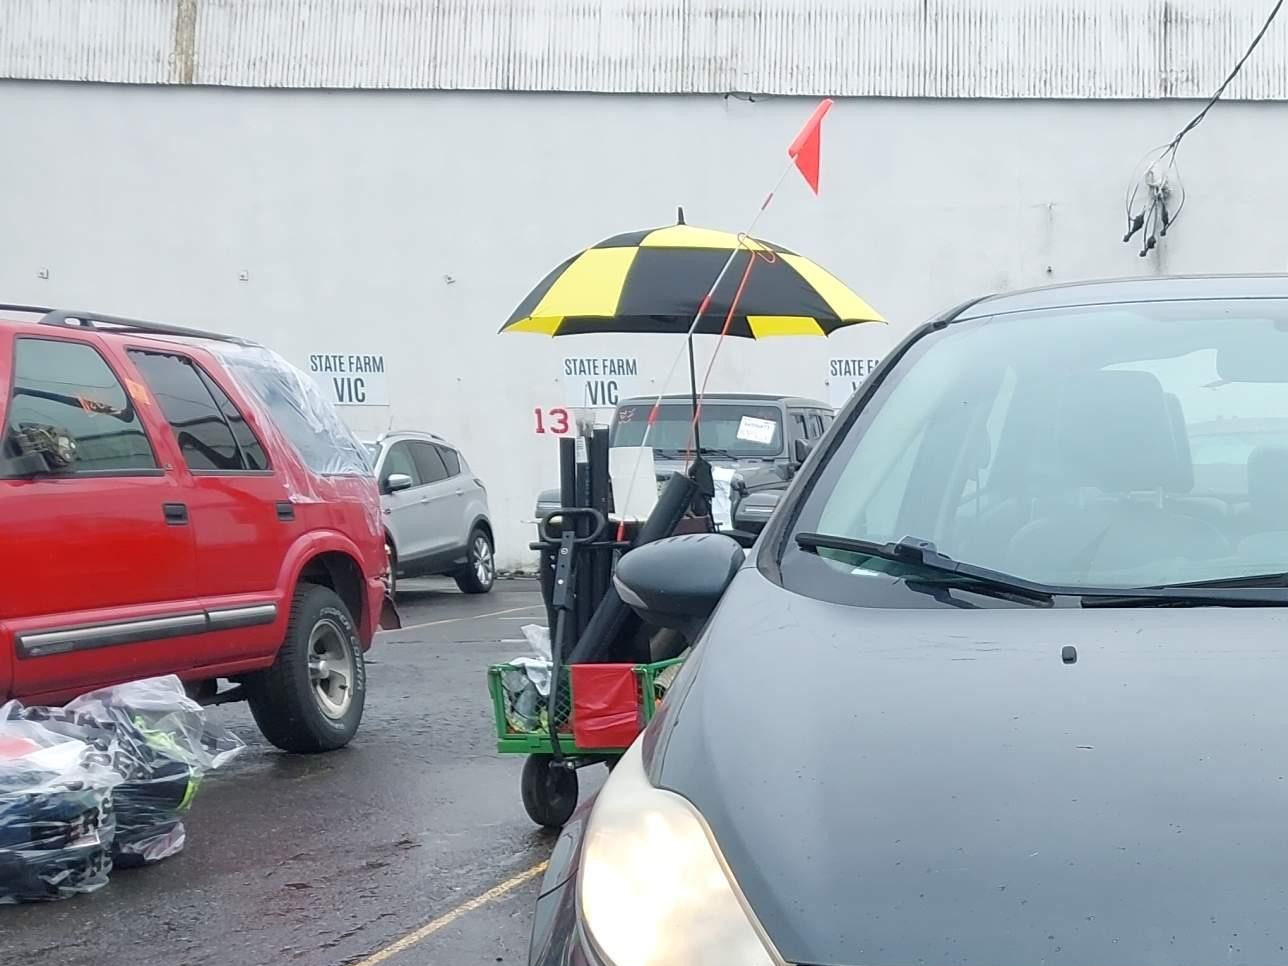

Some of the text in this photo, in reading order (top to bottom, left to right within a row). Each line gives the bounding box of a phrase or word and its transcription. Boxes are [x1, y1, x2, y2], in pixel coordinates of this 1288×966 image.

[310, 355, 385, 373] STATE FARM
[564, 358, 638, 376] STATE FARM
[830, 359, 864, 377] STATE
[333, 377, 366, 403] VIC
[587, 380, 619, 405] VIC
[534, 408, 569, 434] 13
